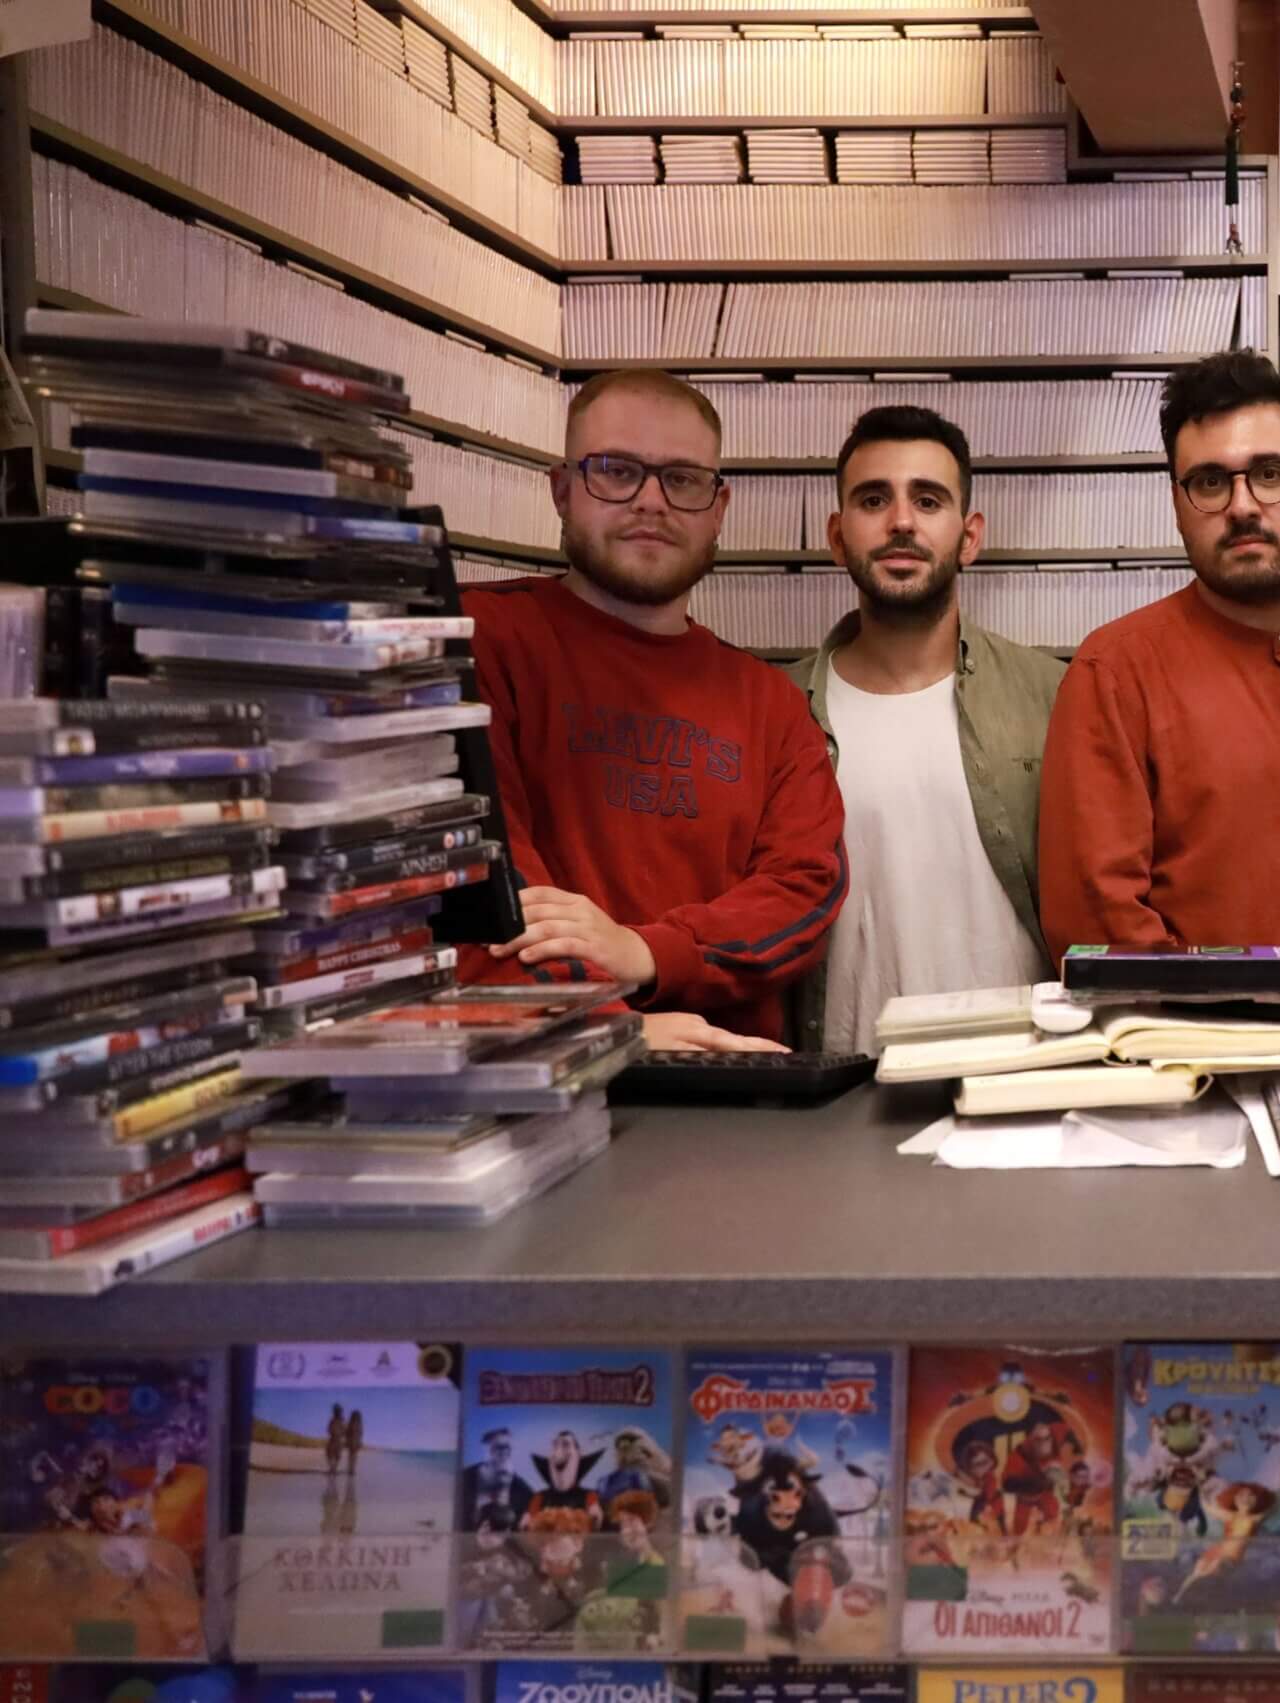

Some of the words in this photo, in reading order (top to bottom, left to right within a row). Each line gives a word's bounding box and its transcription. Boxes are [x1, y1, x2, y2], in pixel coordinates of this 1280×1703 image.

[604, 764, 697, 818] USA
[351, 941, 402, 962] CHRISTMAS
[43, 1384, 161, 1415] COCO
[633, 1367, 652, 1405] 2
[277, 1570, 401, 1593] ΧΕΛΩΝΑ
[934, 1600, 957, 1637] ΟΙ
[963, 1606, 1063, 1639] ΑΠΙΘΑΝΟΙ
[1065, 1601, 1082, 1638] 2
[954, 1679, 1059, 1703] PETER
